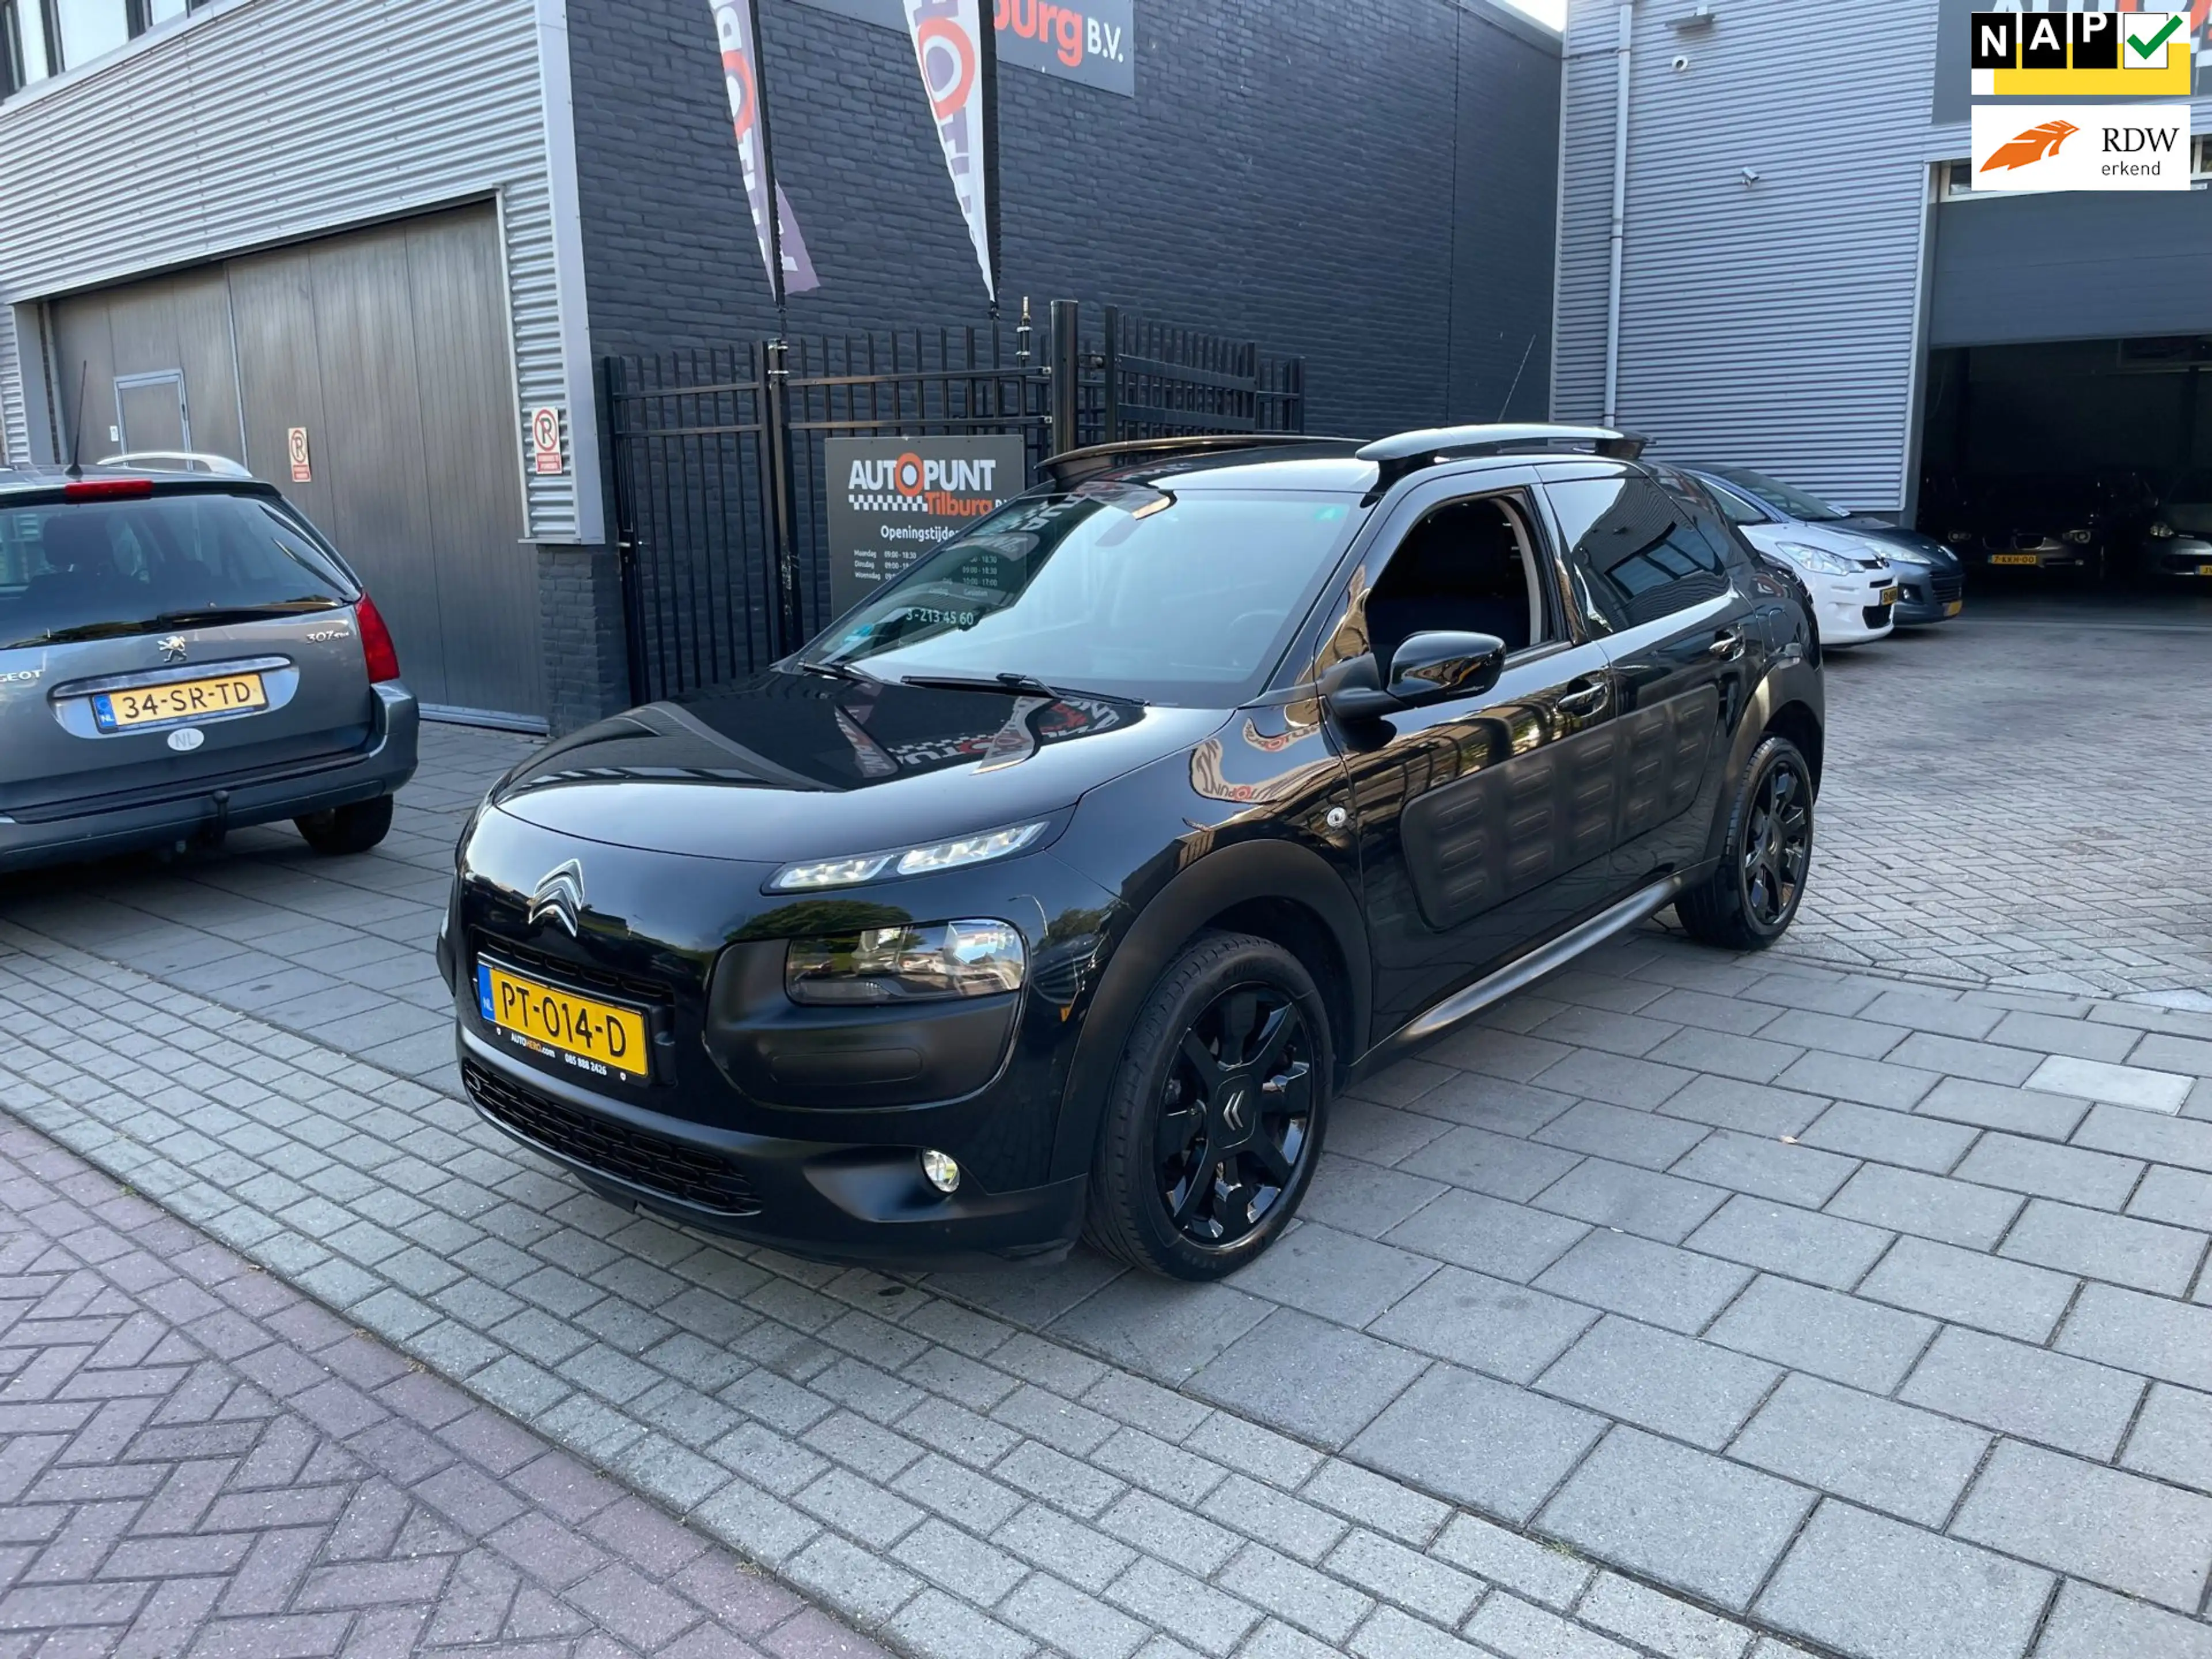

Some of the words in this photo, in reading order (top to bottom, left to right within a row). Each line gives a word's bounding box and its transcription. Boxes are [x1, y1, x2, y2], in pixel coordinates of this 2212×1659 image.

[1088, 16, 1123, 63] B.V.
[849, 452, 996, 497] AUTOPUNT
[943, 611, 956, 624] 45
[960, 612, 974, 626] 60
[122, 681, 250, 718] 34-SR-TD
[174, 732, 198, 748] NL
[501, 980, 627, 1058] PT-014-D
[565, 1052, 577, 1066] 085
